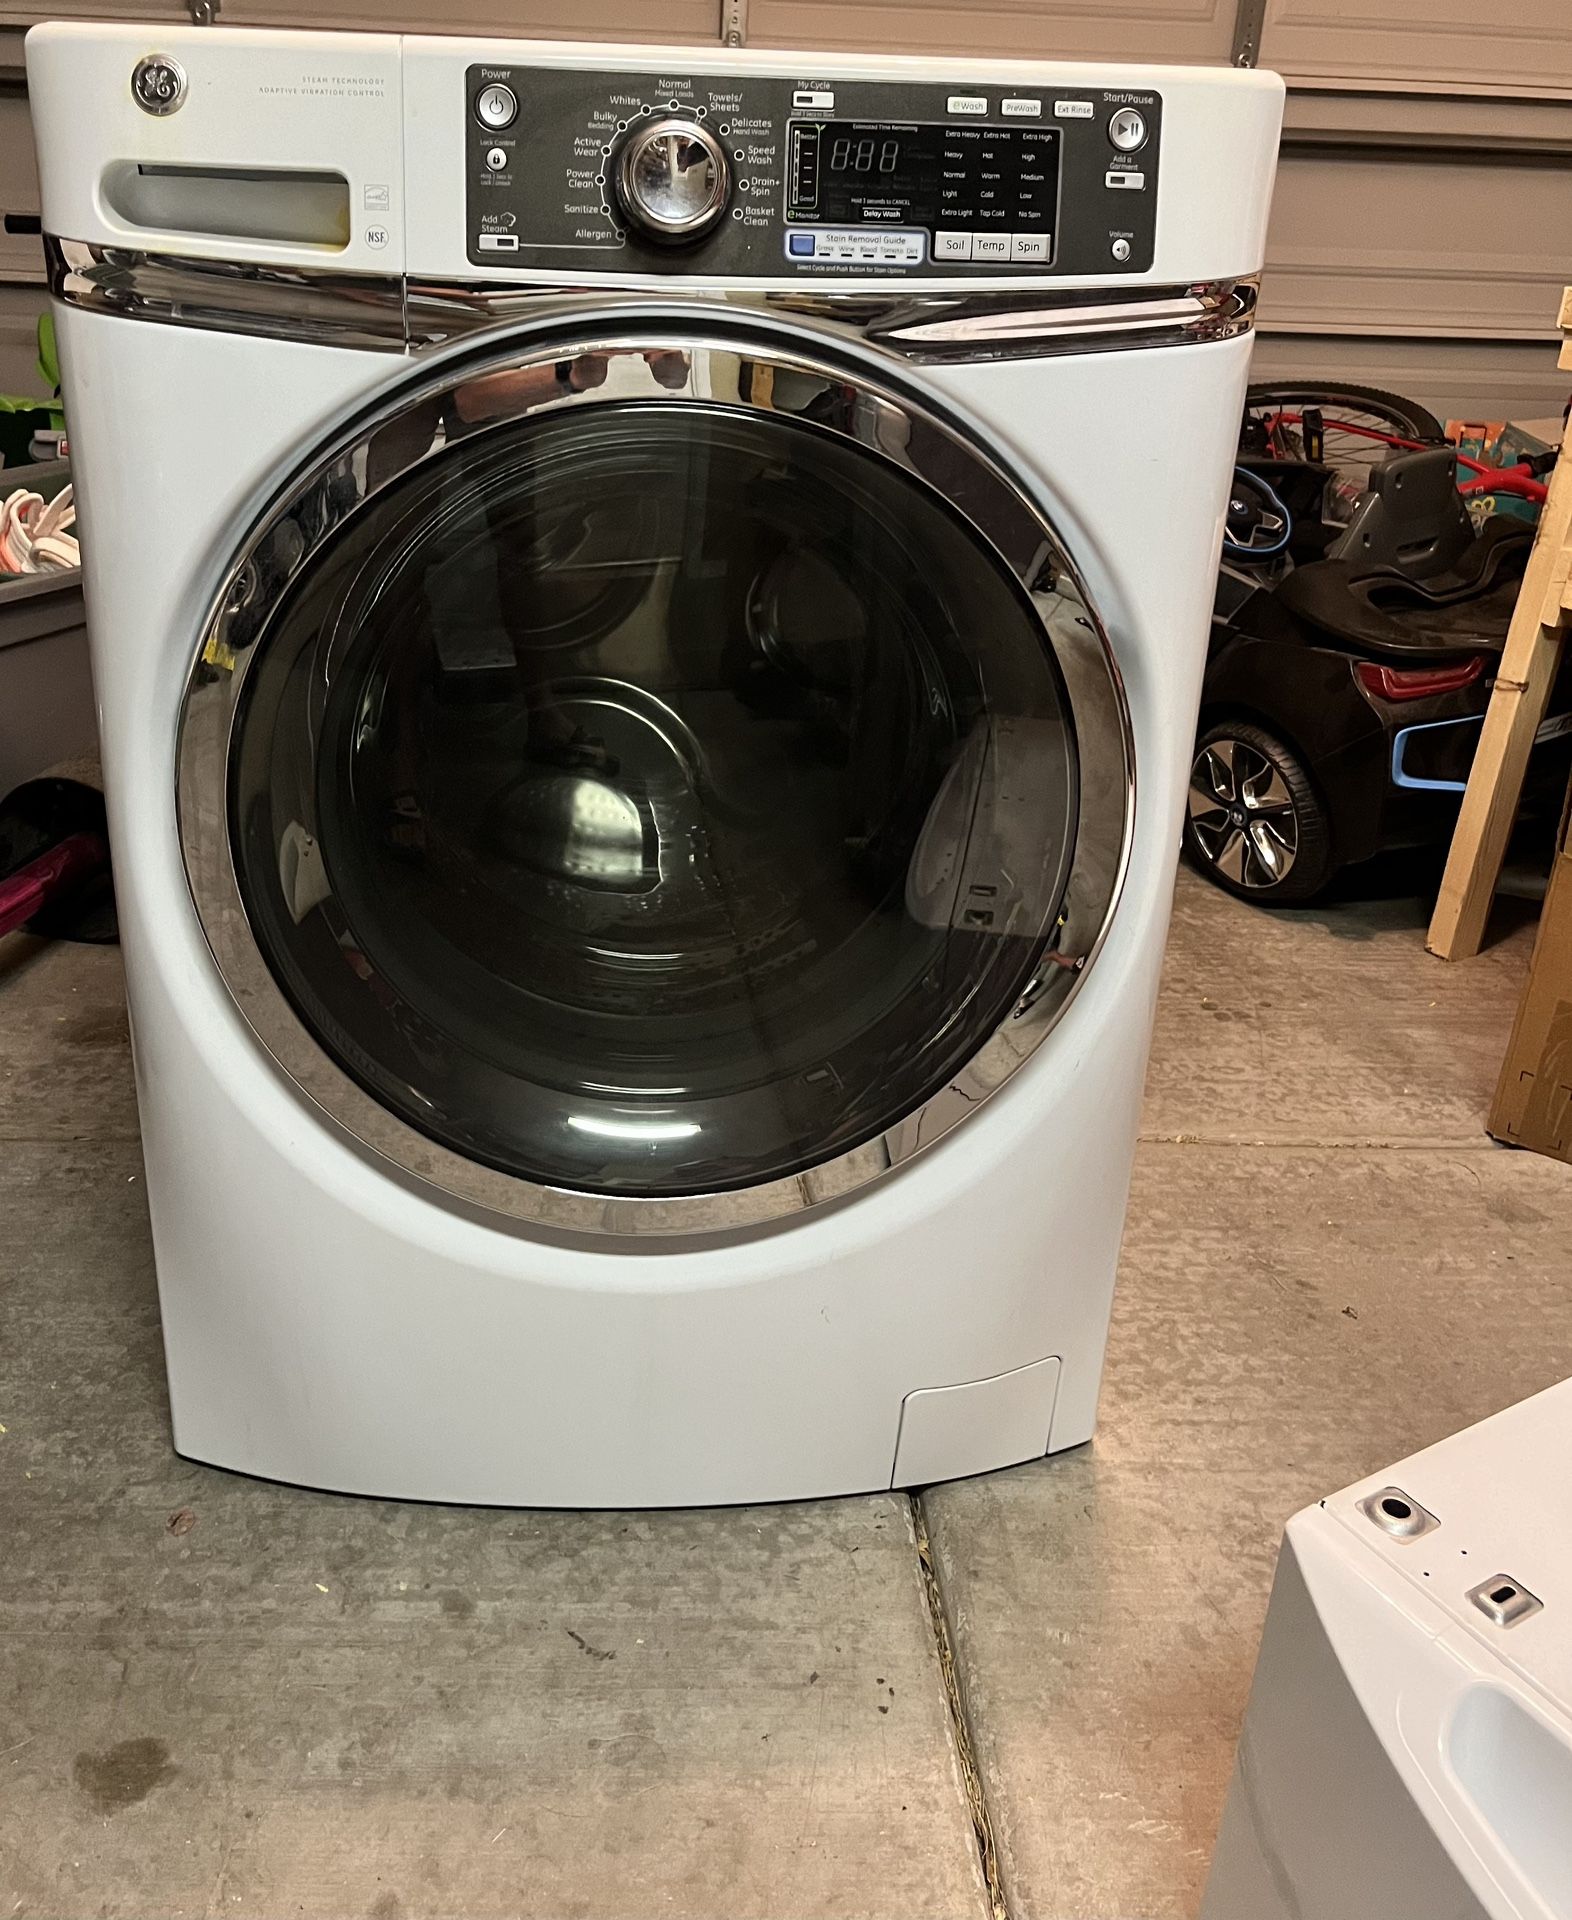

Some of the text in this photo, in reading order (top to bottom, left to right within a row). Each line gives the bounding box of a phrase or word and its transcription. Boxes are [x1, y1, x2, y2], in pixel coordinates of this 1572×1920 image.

[481, 69, 511, 79] Power
[332, 77, 384, 85] TECHNOLOGY
[658, 79, 691, 89] Normal
[797, 80, 830, 90] My Cycle
[347, 89, 384, 97] CONTROL
[708, 92, 743, 103] Towels/
[609, 95, 641, 106] Whites
[1103, 92, 1154, 105] Start/Pause
[710, 103, 740, 112] Sheets
[1006, 103, 1039, 113] PreWash
[1057, 105, 1091, 114] Ext Rinse
[593, 112, 617, 122] Bulky
[587, 122, 614, 131] Bedding
[731, 118, 772, 128] Delicates
[945, 130, 981, 140] Extra Heavy
[983, 131, 999, 139] Extra
[1022, 133, 1052, 141] Extra High
[574, 137, 601, 147] Active
[574, 147, 598, 157] Wear
[748, 146, 775, 156] Speed
[944, 151, 963, 159] Heavy
[748, 156, 772, 165] Wash
[1022, 153, 1035, 162] High
[1113, 155, 1126, 163] Add
[1109, 163, 1139, 171] Garment
[566, 169, 594, 179] Power
[943, 171, 966, 179] Normal
[981, 172, 1000, 180] Warm
[1020, 173, 1044, 181] Medium
[568, 179, 594, 188] Clean
[751, 176, 780, 186] Drain+
[750, 187, 770, 196] Spin
[943, 190, 957, 198] Light
[564, 204, 599, 214] Sanitize
[745, 206, 775, 216] Basket
[941, 208, 957, 216] Extra
[958, 209, 973, 218] Light
[863, 210, 901, 219] Delay Wash
[980, 210, 991, 218] Tap
[481, 215, 498, 223] Add
[743, 217, 769, 226] Clean
[481, 225, 508, 233] Steam
[368, 232, 384, 243] NSF
[575, 230, 612, 240] Allergen
[826, 234, 906, 244] Stain Removal Guide
[1108, 230, 1134, 239] Volume
[946, 240, 965, 250] Soil
[977, 240, 1005, 252] Temp
[1018, 241, 1040, 254] Spin
